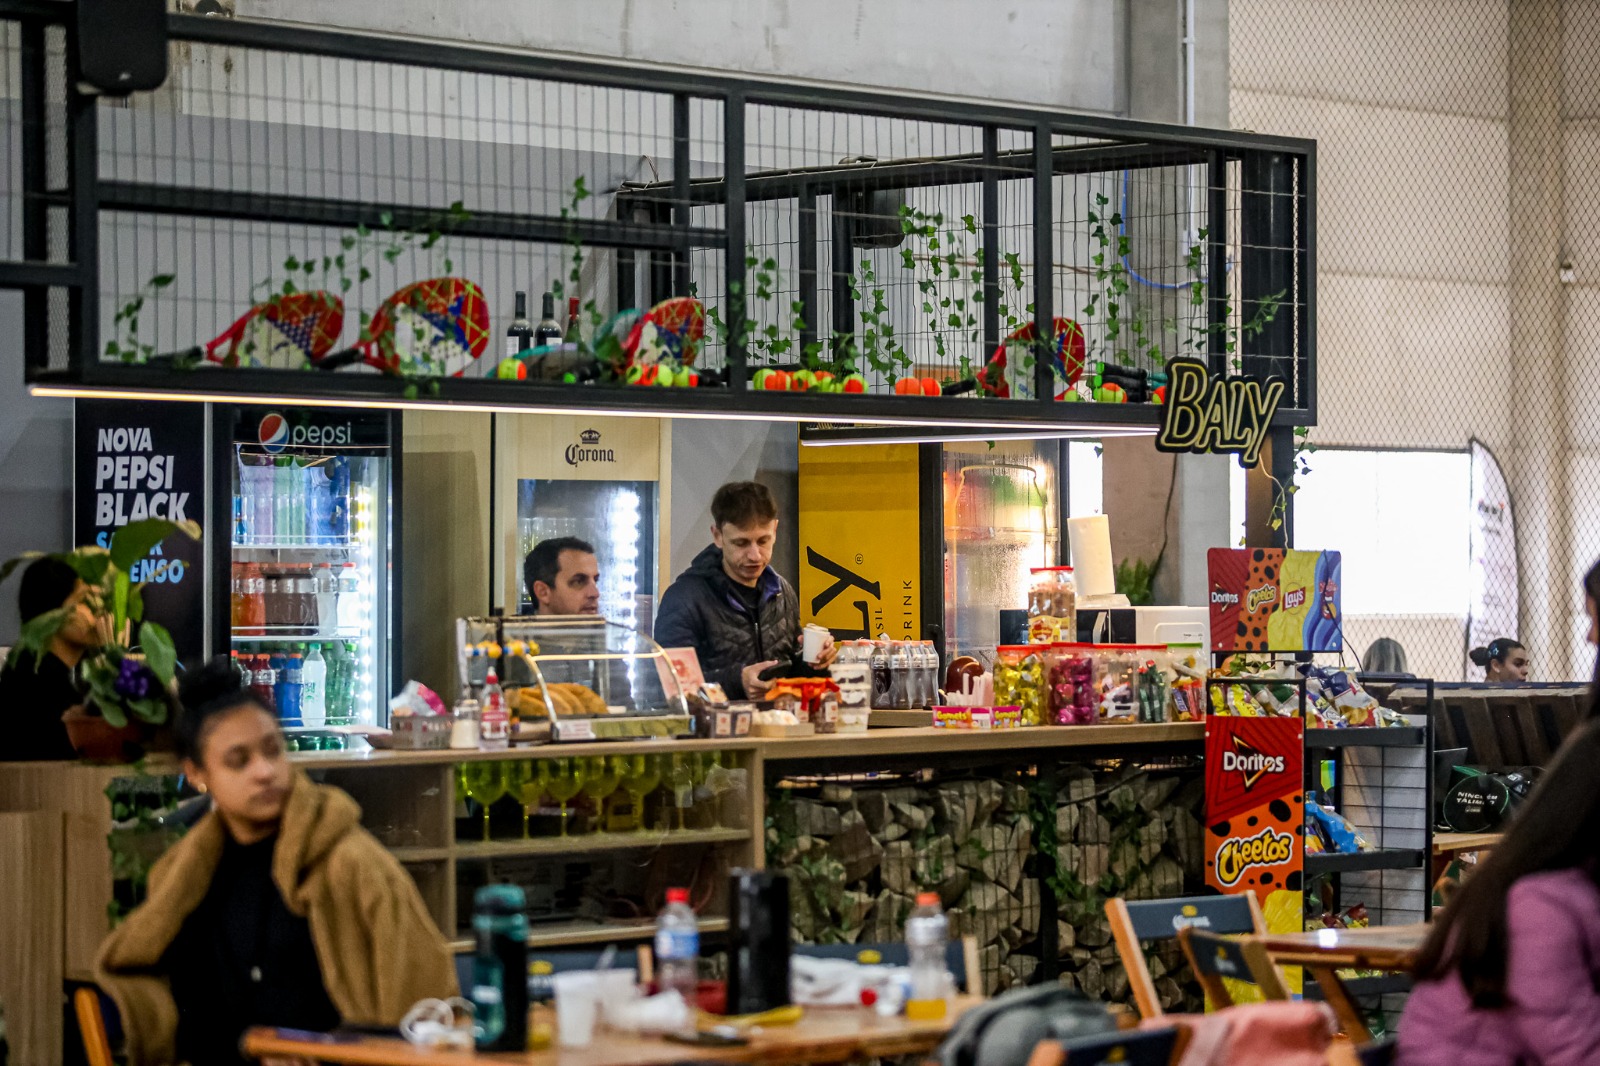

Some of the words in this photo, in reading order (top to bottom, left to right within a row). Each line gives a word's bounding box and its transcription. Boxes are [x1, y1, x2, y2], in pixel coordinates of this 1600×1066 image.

[1159, 362, 1285, 463] BALY
[97, 427, 153, 452] NOVA
[292, 421, 352, 454] pepsi
[565, 444, 615, 467] Corona
[95, 455, 174, 490] PEPSI
[95, 492, 190, 526] BLACK
[130, 559, 184, 583] ENSO
[806, 546, 881, 641] LY
[1211, 591, 1239, 603] Doritos
[1223, 751, 1285, 772] Doritos
[1218, 832, 1291, 882] Cheetos
